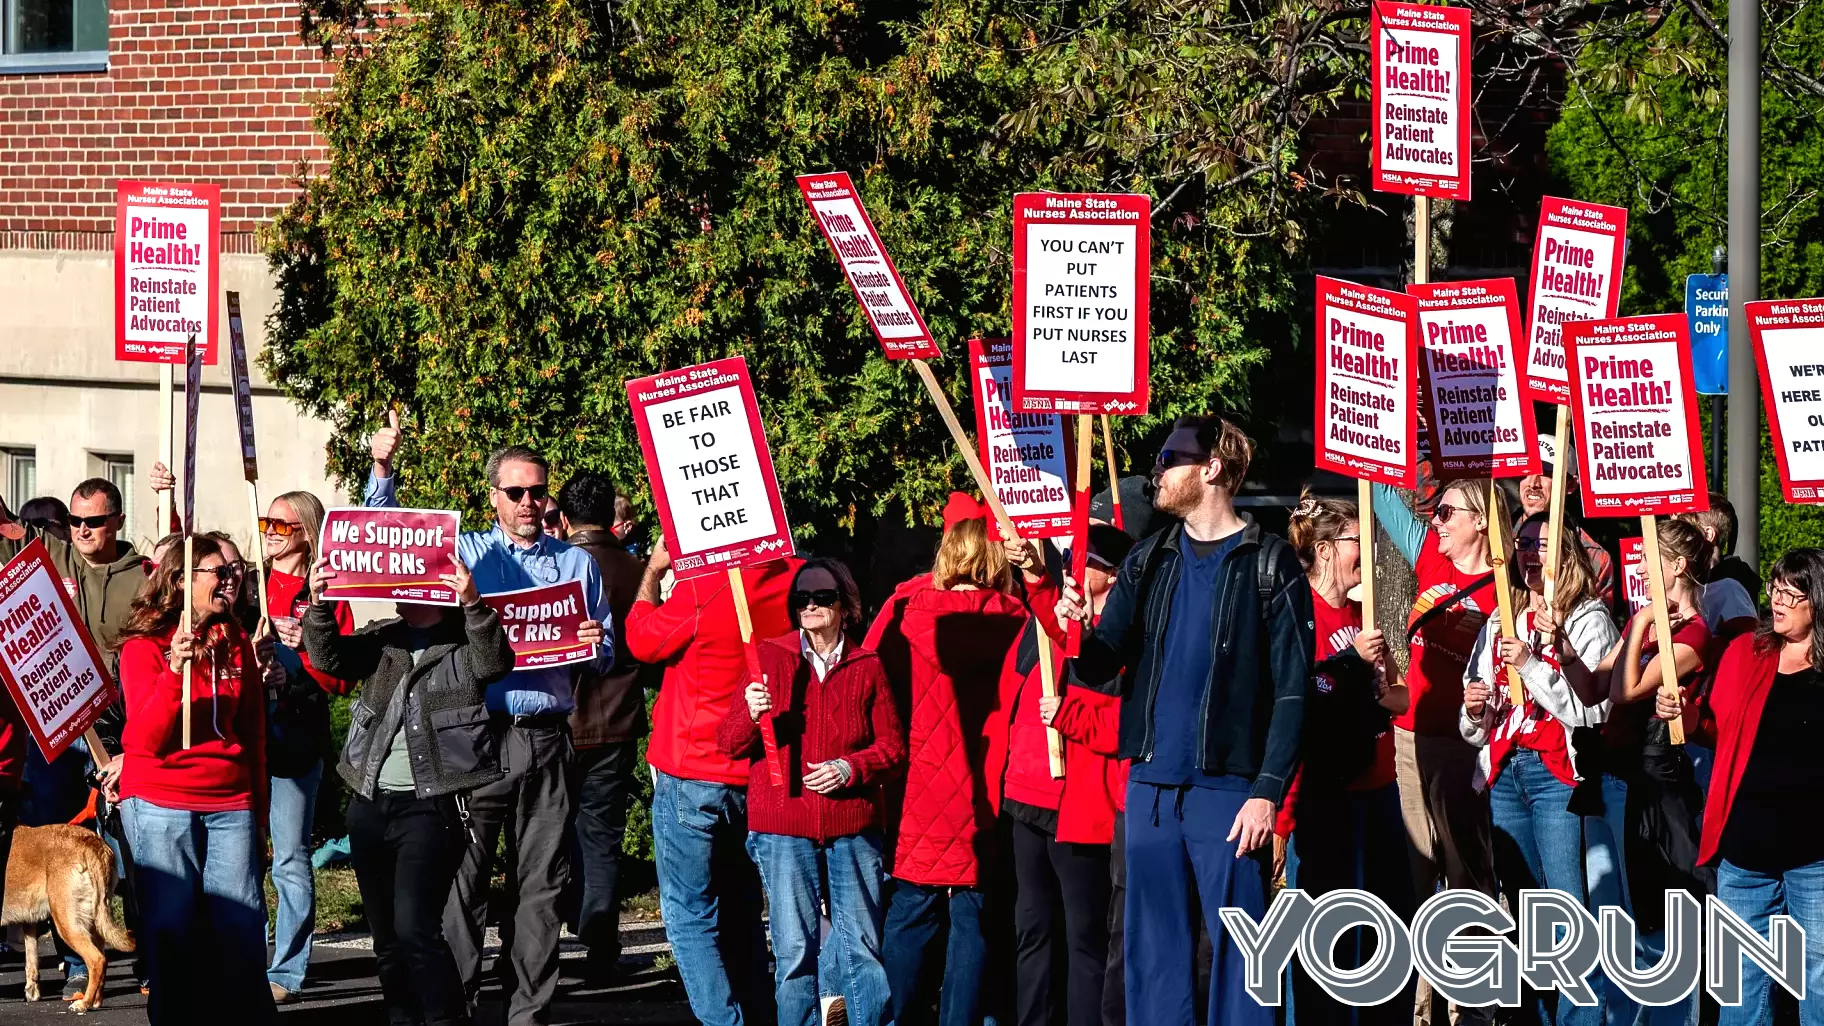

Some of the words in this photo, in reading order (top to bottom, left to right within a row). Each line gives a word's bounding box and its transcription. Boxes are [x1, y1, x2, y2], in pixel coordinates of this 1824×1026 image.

[1382, 16, 1409, 26] Nurses
[1411, 19, 1459, 30] Association
[1397, 8, 1421, 18] Maine
[1424, 11, 1444, 20] State
[1386, 39, 1439, 66] Prime
[1386, 66, 1450, 93] Health!
[1386, 103, 1447, 124] Reinstate
[1386, 123, 1434, 143] Patient
[1386, 143, 1453, 165] Advocates
[128, 195, 156, 203] Nurses
[158, 196, 208, 205] Association
[144, 187, 167, 195] Maine
[170, 188, 192, 196] State
[1046, 198, 1082, 208] Maine
[1086, 199, 1117, 208] State
[1562, 205, 1583, 216] Maine
[1584, 209, 1603, 220] State
[819, 210, 856, 232] Prime
[1024, 208, 1066, 218] Nurses
[1069, 209, 1139, 219] Association
[1548, 213, 1571, 224] Nurses
[1572, 217, 1616, 231] Association
[131, 217, 187, 240] Prime
[131, 242, 200, 265] Health!
[833, 234, 877, 258] Health!
[1041, 239, 1073, 252] YOU
[1078, 241, 1124, 254] CAN'T
[1545, 237, 1594, 268] Prime
[1067, 262, 1097, 275] PUT
[131, 277, 196, 294] Reinstate
[851, 271, 890, 288] Reinstate
[1542, 265, 1603, 298] Health!
[861, 290, 893, 307] Patient
[1045, 284, 1117, 298] PATIENTS
[1340, 287, 1365, 300] Maine
[1368, 294, 1390, 305] State
[1433, 289, 1459, 297] Maine
[1462, 287, 1486, 295] State
[1696, 288, 1728, 300] Securi
[131, 296, 180, 313] Patient
[1326, 293, 1353, 307] Nurses
[1356, 301, 1406, 318] Association
[1419, 299, 1448, 307] Nurses
[1451, 295, 1505, 306] Association
[1696, 304, 1728, 316] Parkin
[1771, 305, 1800, 314] Maine
[1802, 304, 1824, 313] Stat
[872, 309, 914, 326] Advocates
[1033, 306, 1073, 319] FIRST
[1078, 307, 1090, 319] IF
[1095, 308, 1128, 321] YOU
[1755, 316, 1789, 325] Nurses
[1792, 313, 1824, 323] Associ
[131, 315, 201, 333] Advocates
[1427, 320, 1487, 345] Prime
[1593, 324, 1624, 334] Maine
[1628, 323, 1656, 332] State
[1695, 321, 1720, 336] Only
[1033, 328, 1063, 341] PUT
[1068, 329, 1127, 342] NURSES
[1331, 318, 1384, 352] Prime
[1536, 326, 1564, 347] Pati
[1576, 335, 1612, 345] Nurses
[1614, 331, 1676, 342] Association
[992, 344, 1013, 352] Main
[1062, 351, 1097, 364] LAST
[979, 354, 1004, 363] Nurses
[1331, 344, 1398, 381] Health!
[1432, 345, 1506, 372] Health!
[1584, 355, 1653, 379] Prime
[655, 374, 687, 388] Maine
[690, 367, 718, 380] State
[1789, 364, 1824, 377] WE'R
[638, 386, 675, 402] Nurses
[678, 374, 740, 394] Association
[985, 376, 1012, 402] Pri
[1331, 382, 1395, 412] Reinstate
[1437, 385, 1506, 404] Reinstate
[1587, 381, 1672, 407] Health!
[1781, 390, 1821, 403] HERE
[662, 410, 686, 428] BE
[689, 400, 731, 423] FAIR
[1023, 400, 1052, 409] MSNA
[1331, 402, 1379, 430] Patient
[1440, 406, 1494, 425] Patient
[1330, 423, 1400, 453] Advocates
[1445, 426, 1518, 446] Advocates
[1591, 420, 1671, 439] Reinstate
[689, 432, 716, 450] TO
[1593, 441, 1654, 459] Patient
[1792, 440, 1824, 452] PATI
[993, 442, 1054, 463] Reinstate
[679, 454, 740, 480] THOSE
[995, 464, 1041, 484] Patient
[1596, 462, 1682, 480] Advocates
[691, 482, 740, 505] THAT
[998, 485, 1064, 505] Advocates
[1595, 498, 1621, 506] MSNA
[700, 508, 748, 531] CARE
[331, 520, 360, 543] We
[365, 521, 444, 549] Support
[7, 560, 26, 579] State
[330, 550, 383, 574] CMMC
[389, 552, 426, 575] RNs
[5, 557, 41, 595] Association
[1629, 575, 1644, 597] Pri
[503, 594, 578, 621] Support
[0, 594, 41, 643] Prime
[4, 602, 62, 665] Health!
[525, 624, 562, 642] RNs
[21, 638, 73, 691] Reinstate
[29, 663, 72, 708] Patient
[40, 667, 94, 725] Advocates
[49, 729, 68, 747] MSNA
